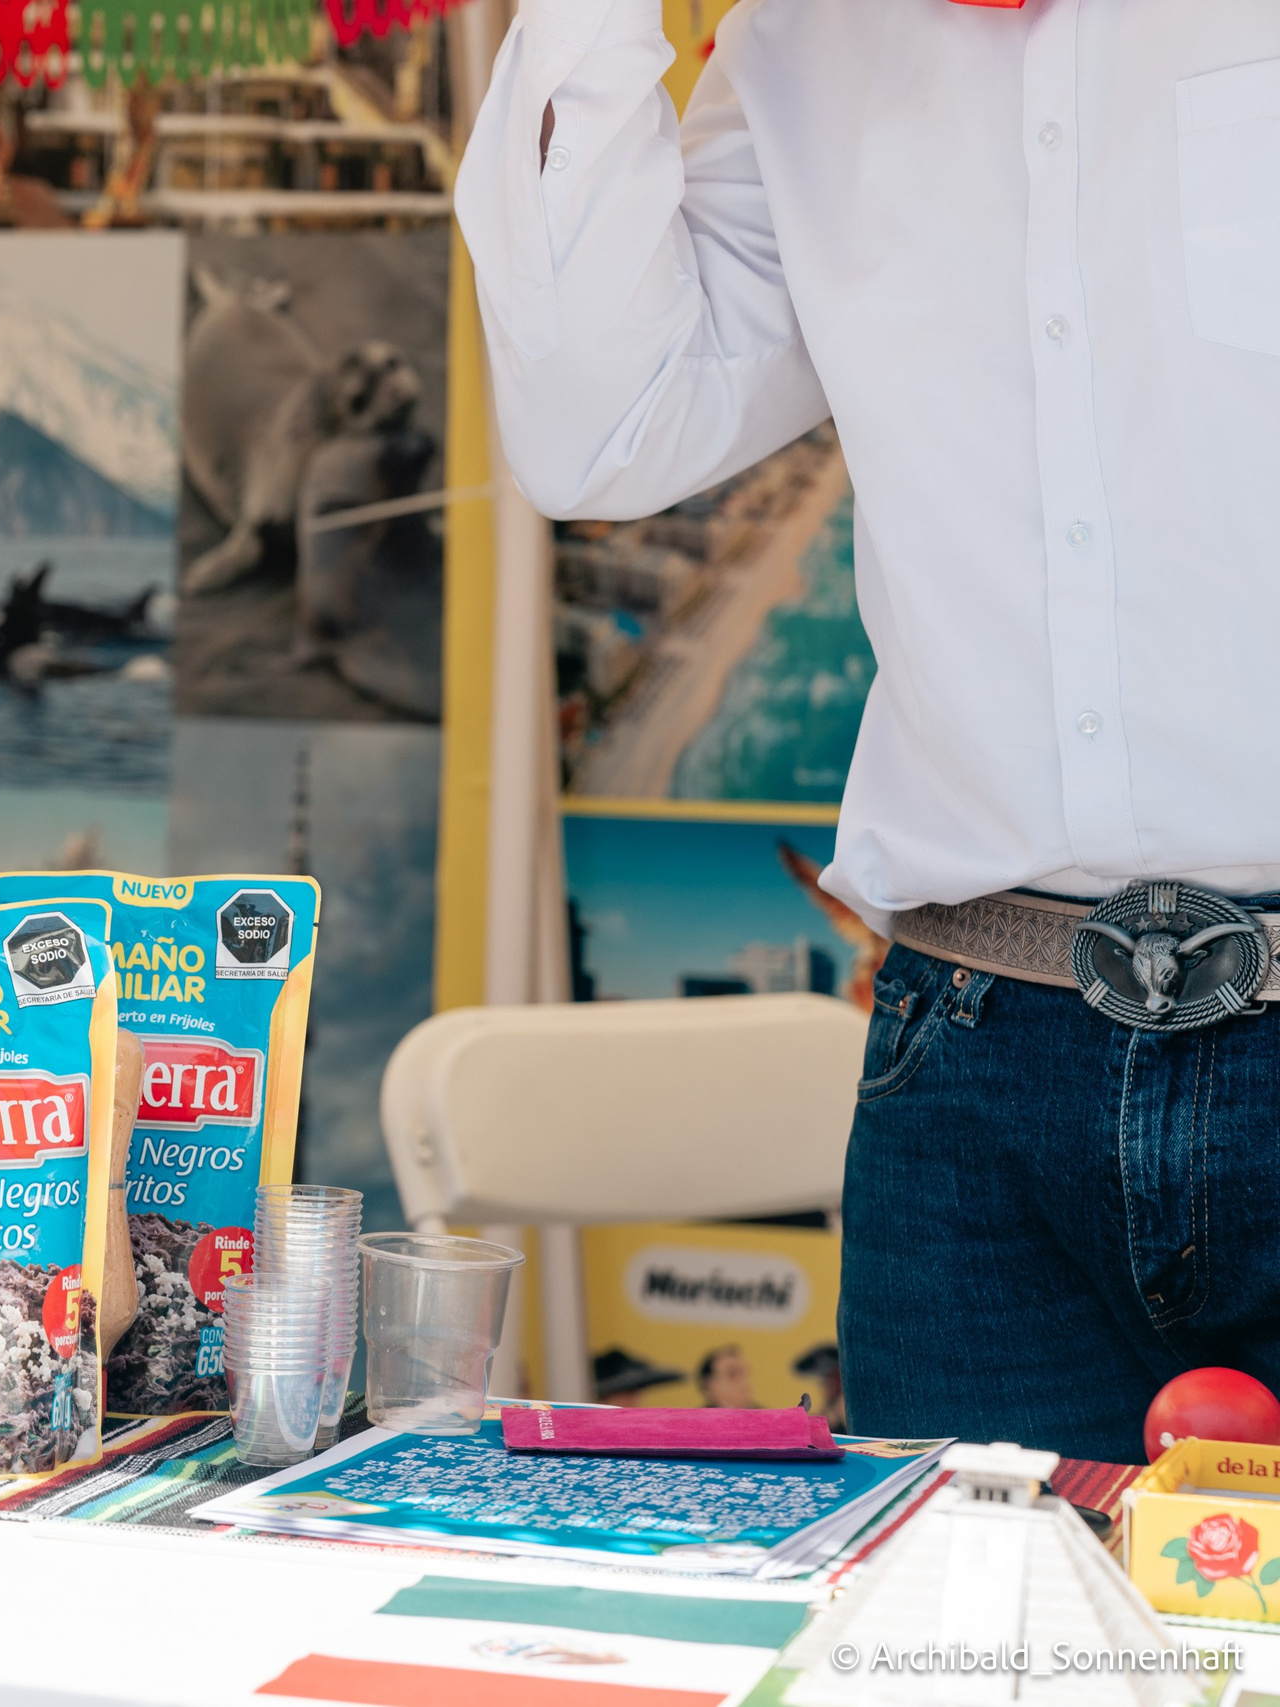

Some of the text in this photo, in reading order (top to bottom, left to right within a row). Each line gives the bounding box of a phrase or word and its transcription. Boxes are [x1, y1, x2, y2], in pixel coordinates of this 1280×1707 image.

[122, 881, 187, 900] NUEVO
[233, 916, 276, 927] EXCESO
[238, 929, 270, 940] SODIO
[22, 938, 69, 953] EXCESO
[112, 936, 205, 973] MAÑO
[30, 950, 66, 964] SODIO
[216, 968, 257, 978] SECRETARÍA
[115, 972, 206, 1003] ILIAR
[19, 993, 62, 1005] SECRETARÍA
[64, 991, 73, 999] DE
[150, 1013, 165, 1023] en
[170, 1013, 216, 1032] Frijoles
[140, 1062, 238, 1112] erra
[140, 1137, 246, 1176] Negros
[215, 1235, 250, 1250] Rinde
[219, 1251, 243, 1287] 5
[65, 1290, 80, 1329] 5
[1217, 1457, 1244, 1475] de
[1248, 1458, 1268, 1477] la
